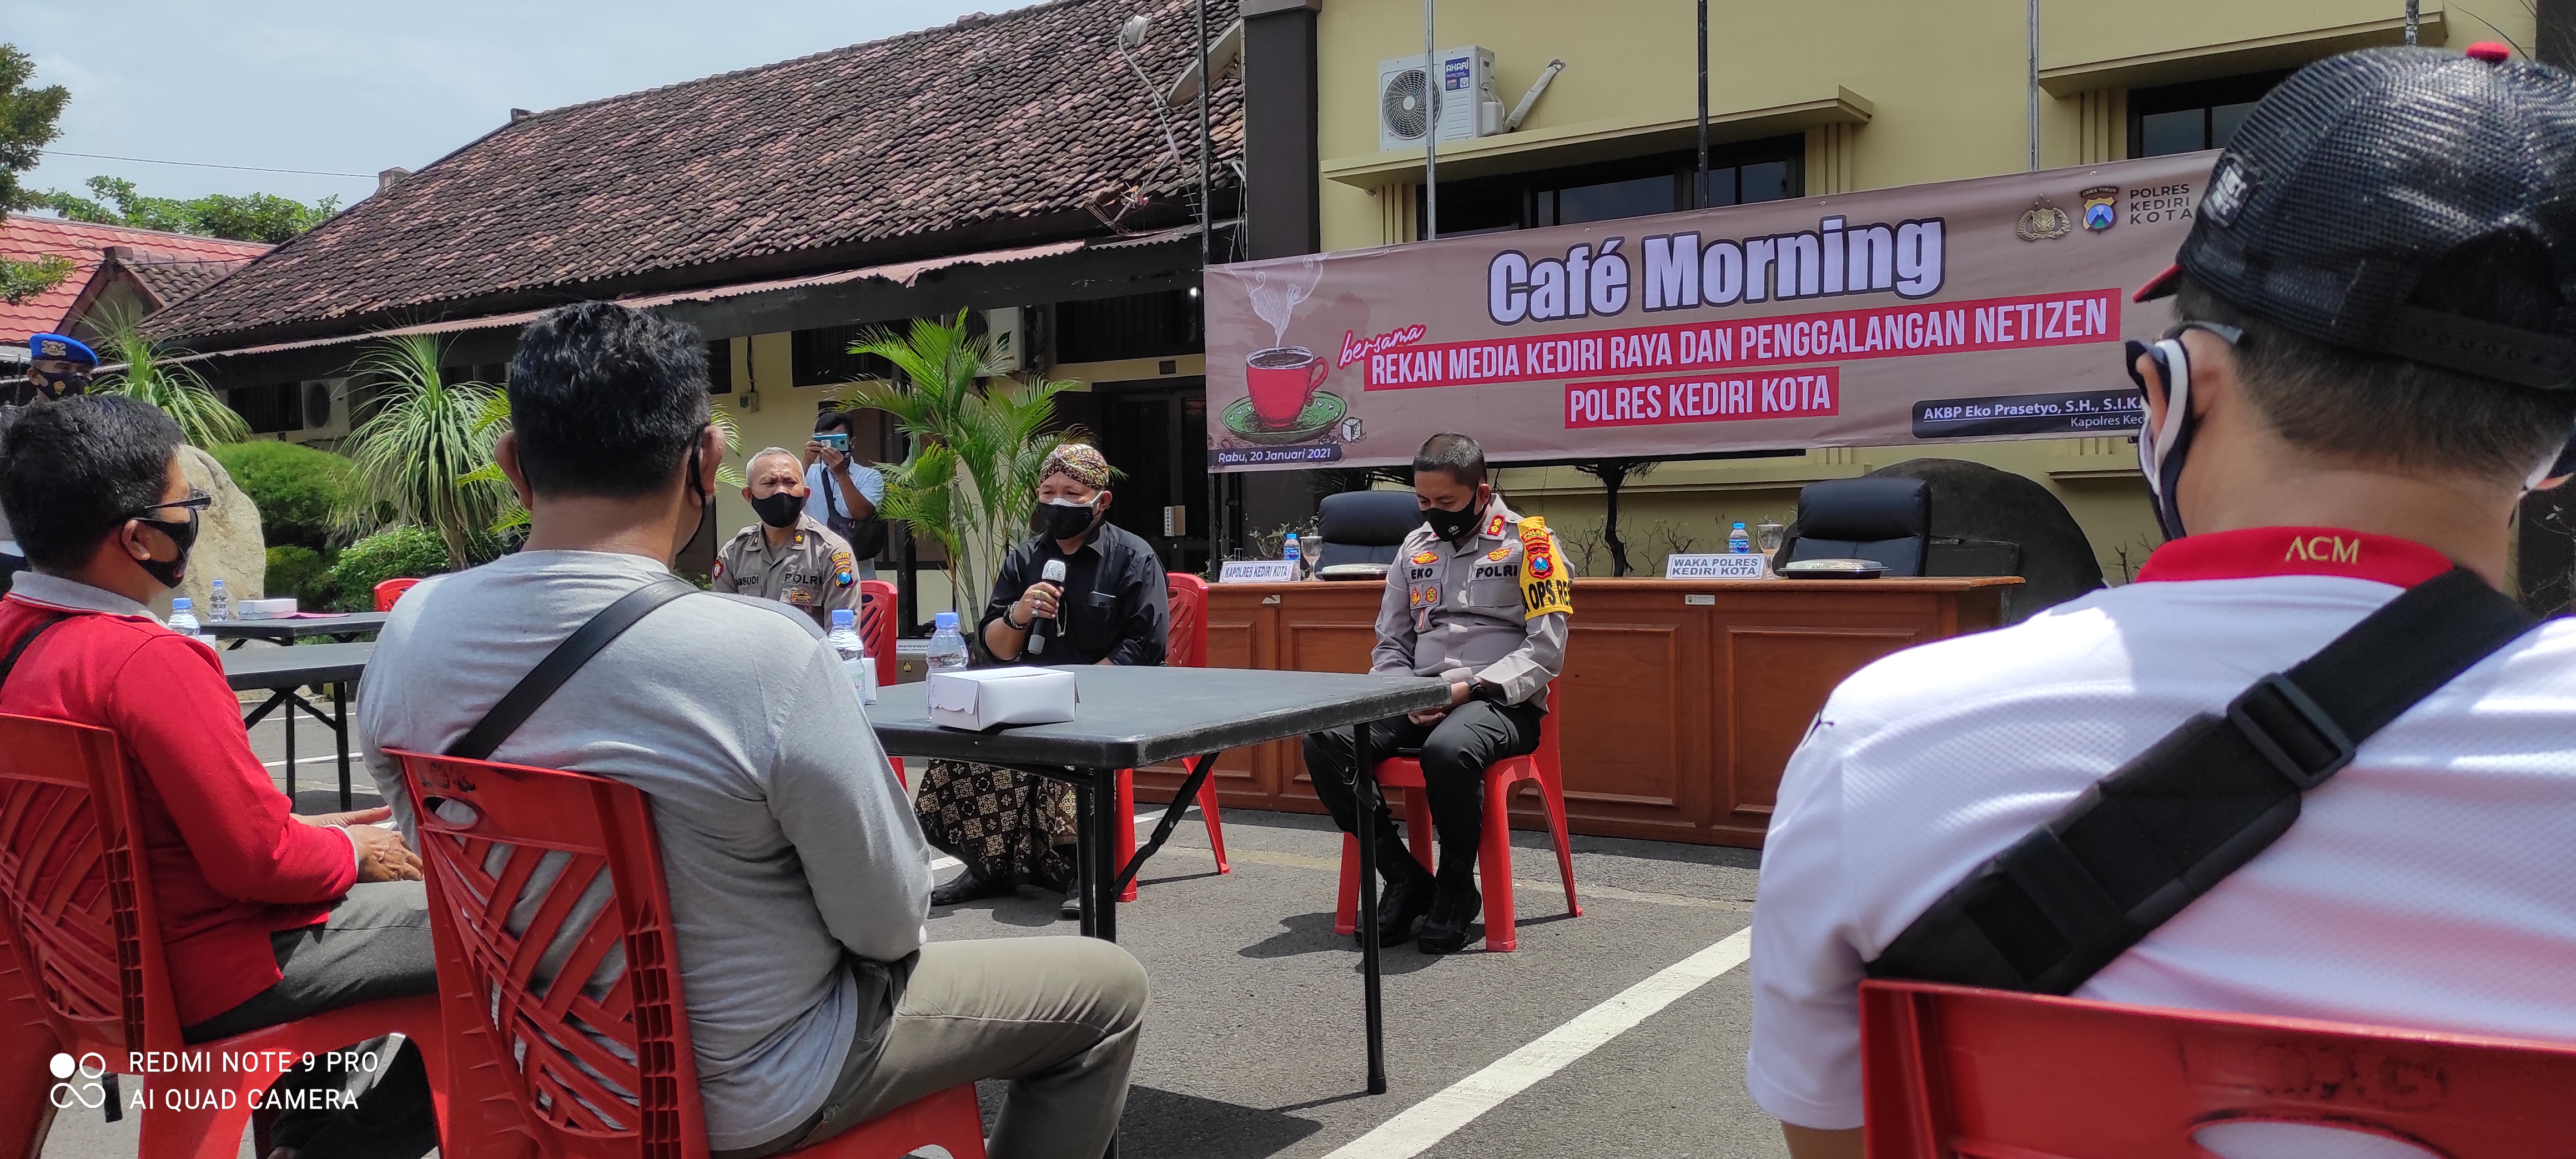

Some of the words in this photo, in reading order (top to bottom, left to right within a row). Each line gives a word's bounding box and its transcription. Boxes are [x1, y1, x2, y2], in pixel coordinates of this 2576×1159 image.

[2130, 183, 2190, 199] POLRES
[2130, 196, 2190, 212] KEDIRI
[2130, 208, 2193, 225] KOTA
[1489, 238, 1629, 324] Café
[1643, 218, 1944, 310] Morning
[1339, 325, 1424, 366] bersama
[1372, 350, 1442, 385] REKAN
[1448, 344, 1520, 380] MEDIA
[1526, 338, 1603, 375] KEDIRI
[1611, 332, 1673, 370] RAYA
[1680, 327, 1732, 365] DAN
[1741, 309, 1965, 360] PENGGALANGAN
[1975, 298, 2107, 344] NETIZEN
[1571, 385, 1662, 422] POLRES
[1669, 379, 1753, 417] KEDIRI
[1762, 374, 1832, 413] KOTA
[1924, 406, 1962, 420] AKBP
[1965, 404, 1991, 419] Eko
[1995, 402, 2061, 416] Prasetyo,
[2065, 399, 2099, 412] S.H.,
[2070, 415, 2120, 429] Kapolres
[2123, 412, 2145, 425] Ked
[1218, 452, 1247, 463] Rabu,
[1249, 451, 1263, 462] 20
[1265, 448, 1306, 461] Januari
[1307, 447, 1331, 459] 2021
[2285, 535, 2361, 565] ACM
[1674, 558, 1708, 567] WAKA
[1712, 558, 1758, 567] POLRES
[1225, 566, 1253, 578] KAPOLRES
[1253, 566, 1273, 577] KEDIRI
[1273, 565, 1288, 577] KOTA
[1411, 566, 1433, 580] EKO
[1476, 564, 1518, 578] POLRI
[1672, 567, 1716, 575] KEDIRI
[1720, 567, 1756, 575] KOTA
[734, 575, 759, 586] SUDI
[784, 573, 822, 586] POLRI
[1528, 579, 1556, 610] OPS
[1556, 580, 1571, 606] RE
